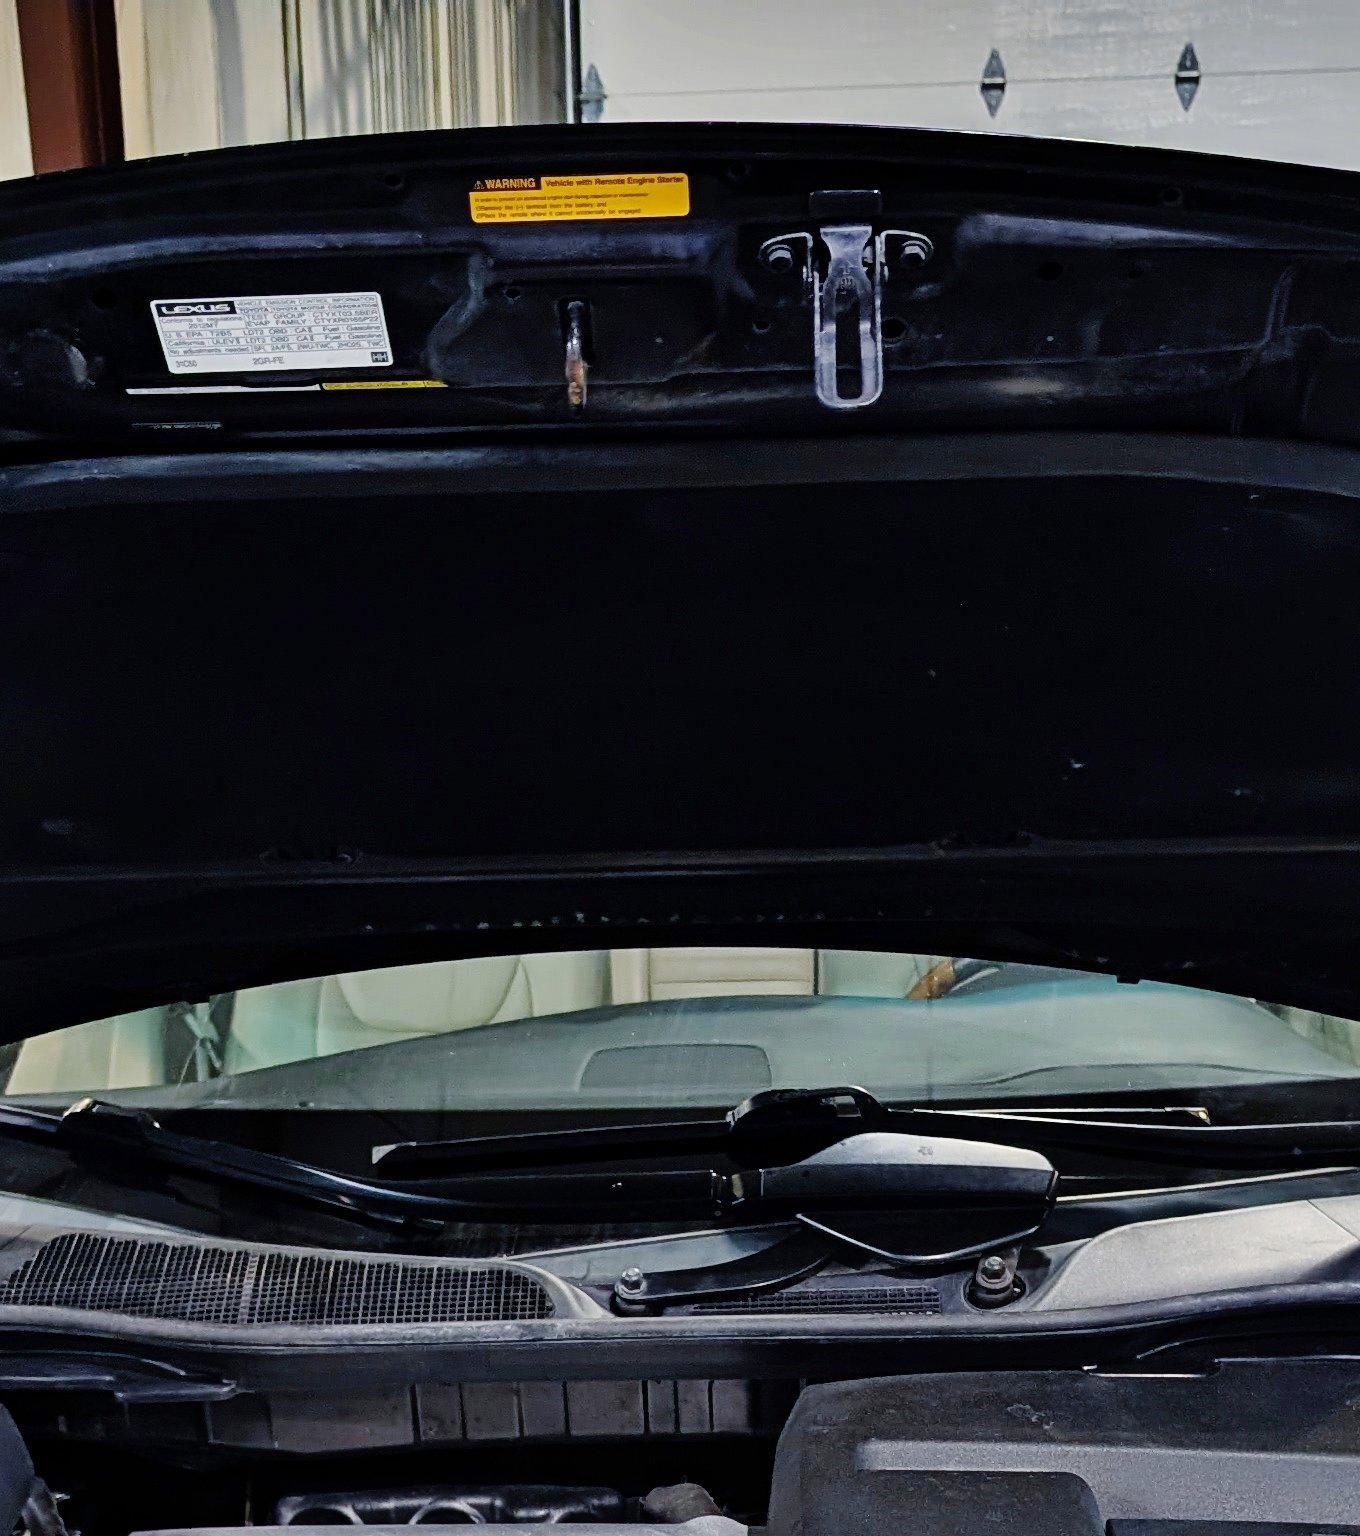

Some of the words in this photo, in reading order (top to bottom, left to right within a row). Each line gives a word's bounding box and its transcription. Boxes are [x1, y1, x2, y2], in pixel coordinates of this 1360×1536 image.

[485, 178, 536, 189] WARNING
[595, 177, 625, 185] Remote
[627, 176, 655, 185] Engine
[657, 176, 684, 184] Starter
[161, 304, 230, 314] LEXUS
